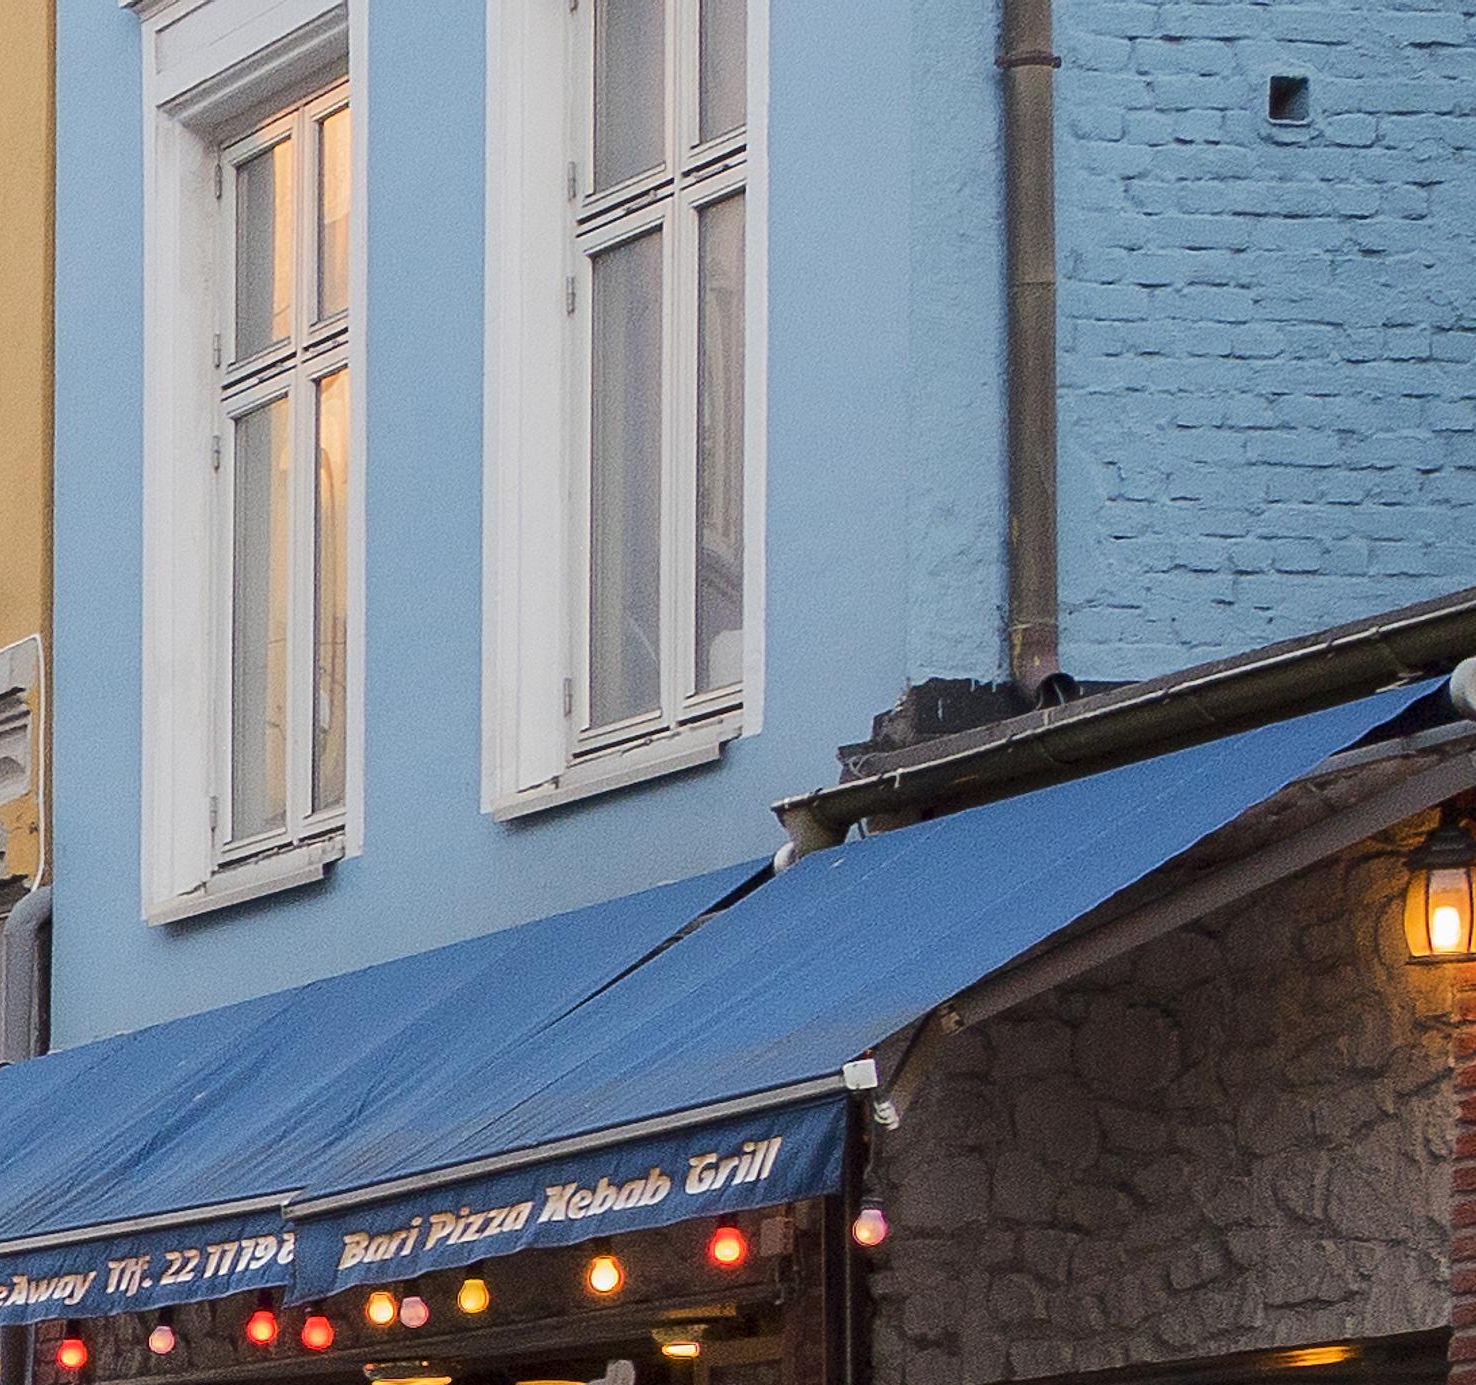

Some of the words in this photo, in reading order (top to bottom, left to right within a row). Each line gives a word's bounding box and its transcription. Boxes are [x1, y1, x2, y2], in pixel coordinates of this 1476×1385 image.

[338, 1217, 423, 1271] Bari
[423, 1200, 533, 1252] Pizza
[536, 1167, 673, 1224] Kebab
[684, 1136, 783, 1196] Grill
[160, 1248, 201, 1286] 22
